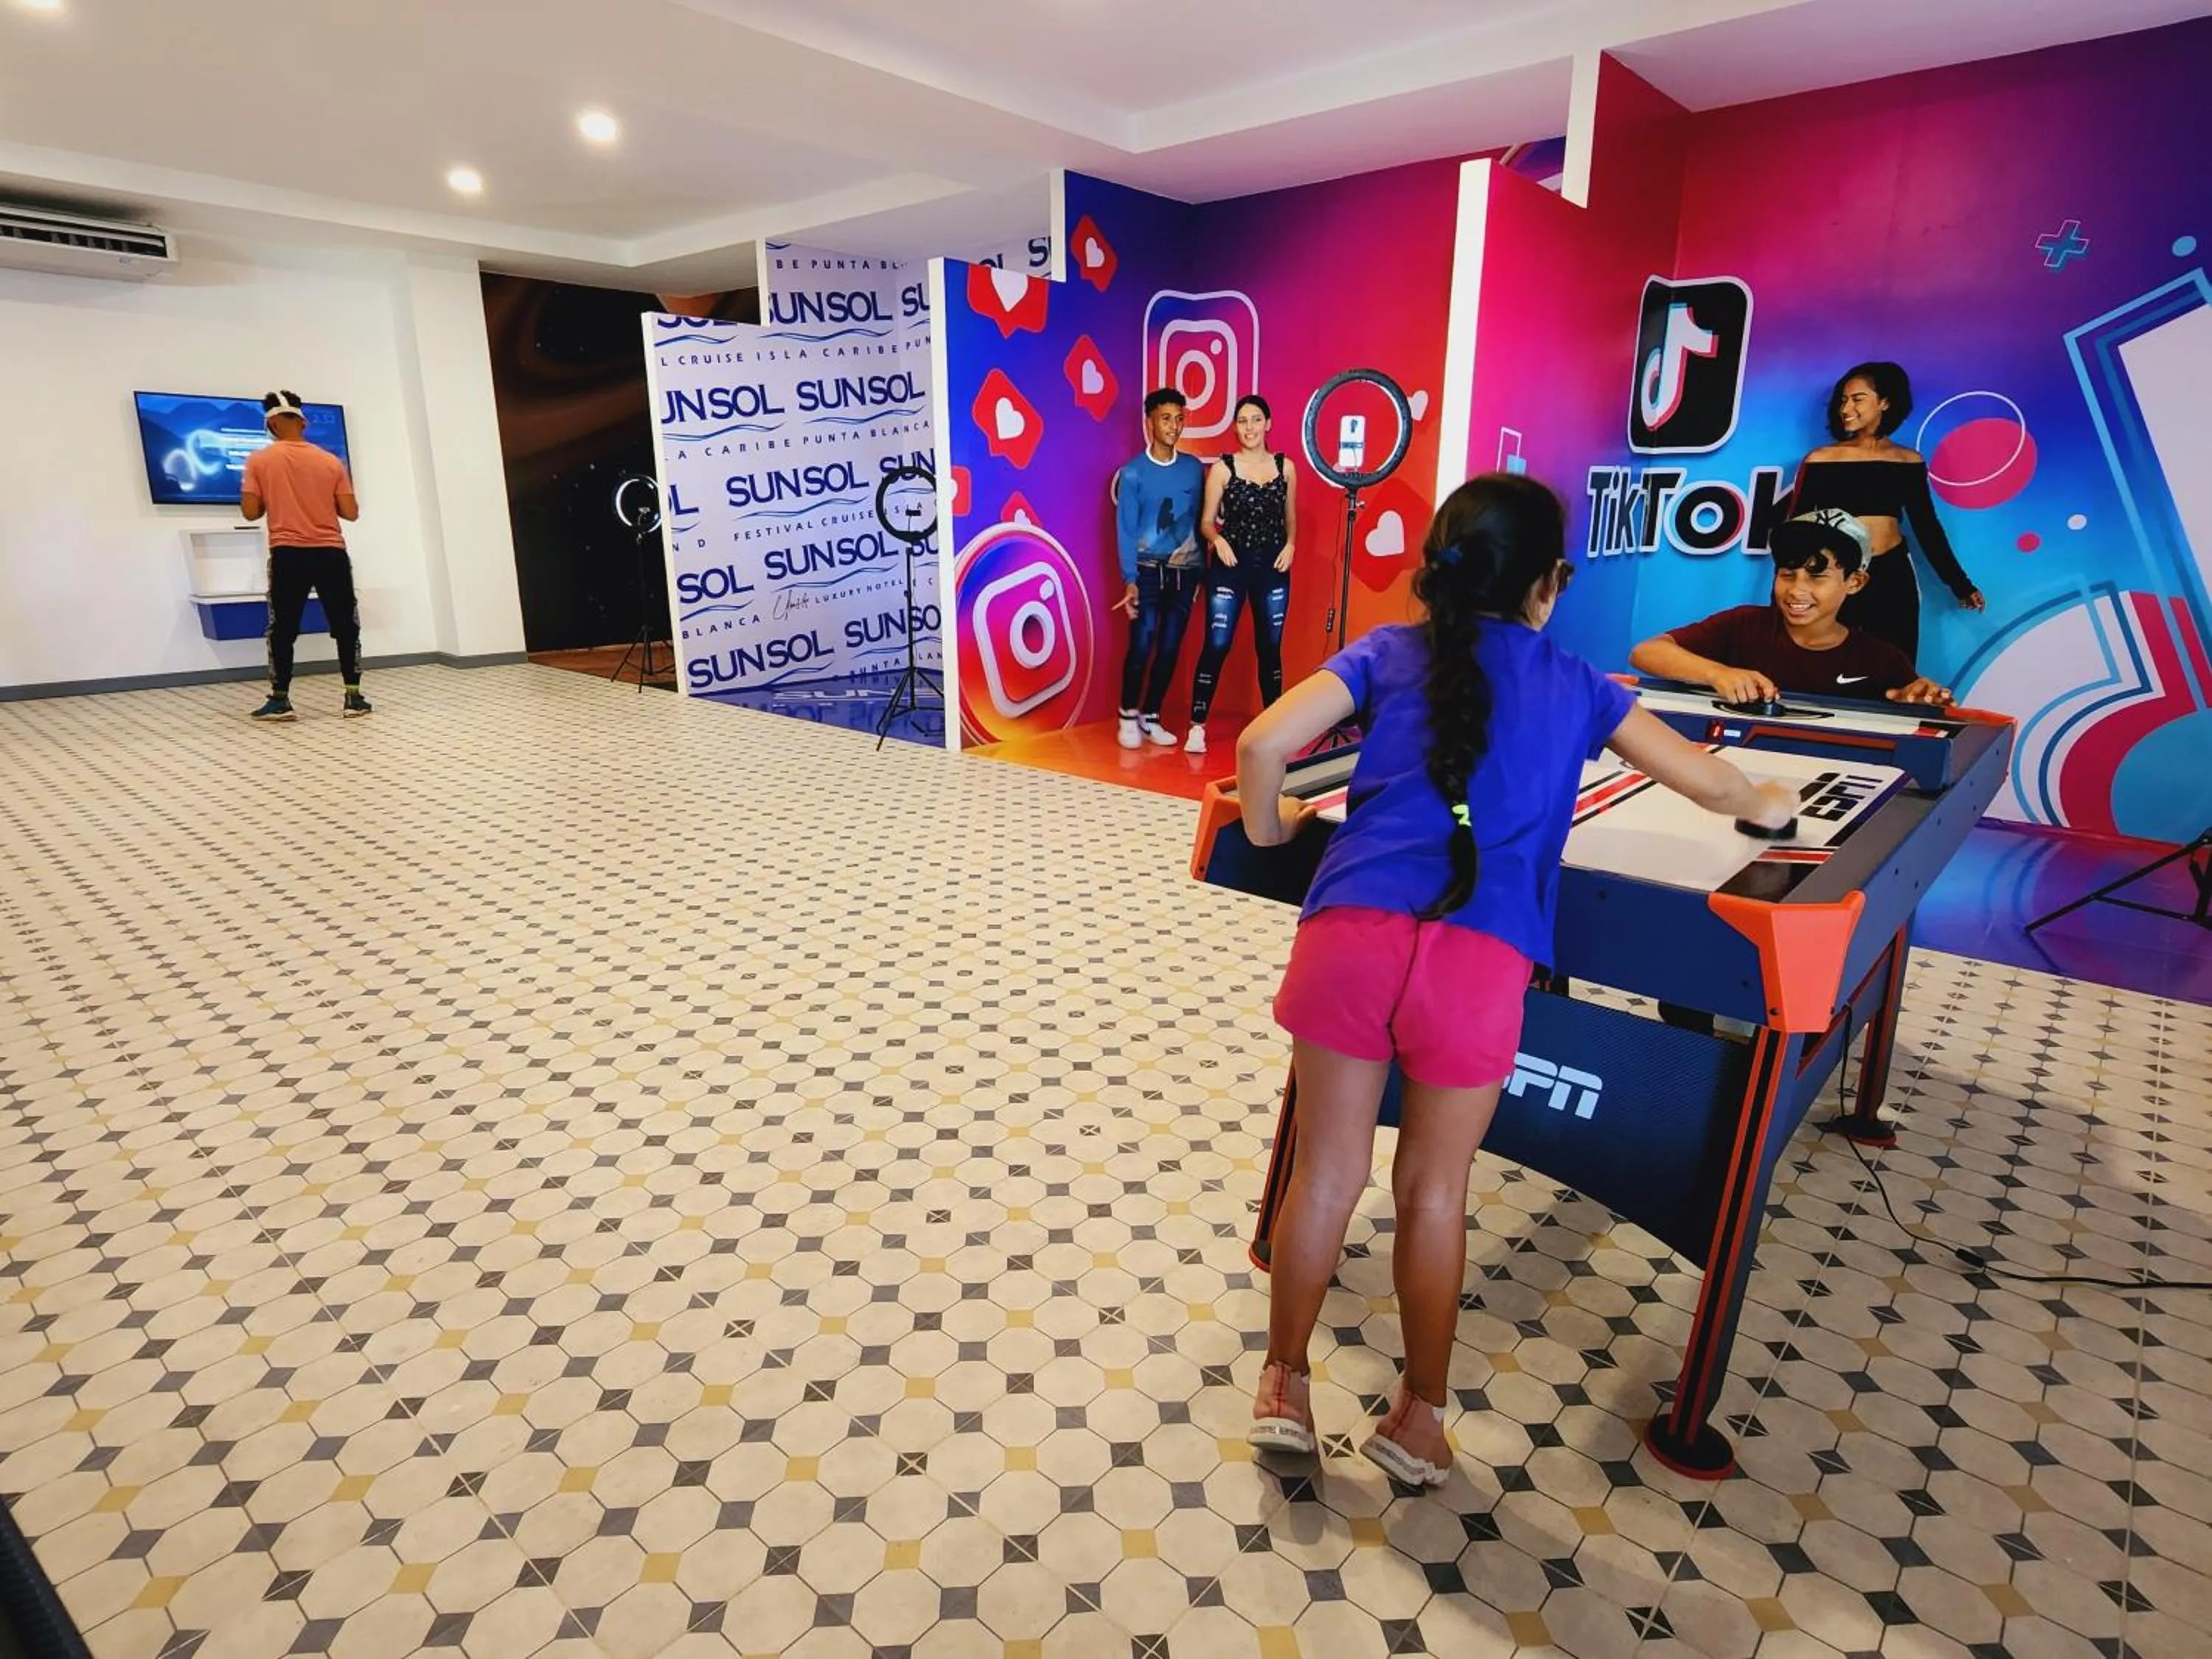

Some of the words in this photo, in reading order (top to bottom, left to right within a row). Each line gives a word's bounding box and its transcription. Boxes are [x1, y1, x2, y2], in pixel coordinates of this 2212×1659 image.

[812, 260, 871, 269] PUNTA
[678, 352, 743, 366] CRUISE
[756, 349, 807, 361] ISLA
[822, 344, 897, 358] CARIBE
[796, 371, 925, 411] SUNSOL
[704, 439, 790, 456] CARIBE
[803, 431, 860, 445] PUNTA
[870, 420, 929, 437] BLANCA
[668, 484, 699, 515] L
[726, 461, 869, 507] SUNSOL
[734, 521, 813, 541] FESTIVAL
[821, 510, 873, 526] CRUISE
[764, 531, 898, 580] SUNSOL
[682, 614, 760, 639] BLANCA
[815, 587, 861, 604] LUXURY
[867, 579, 903, 592] HOTEL
[687, 630, 835, 688] SUNSOL
